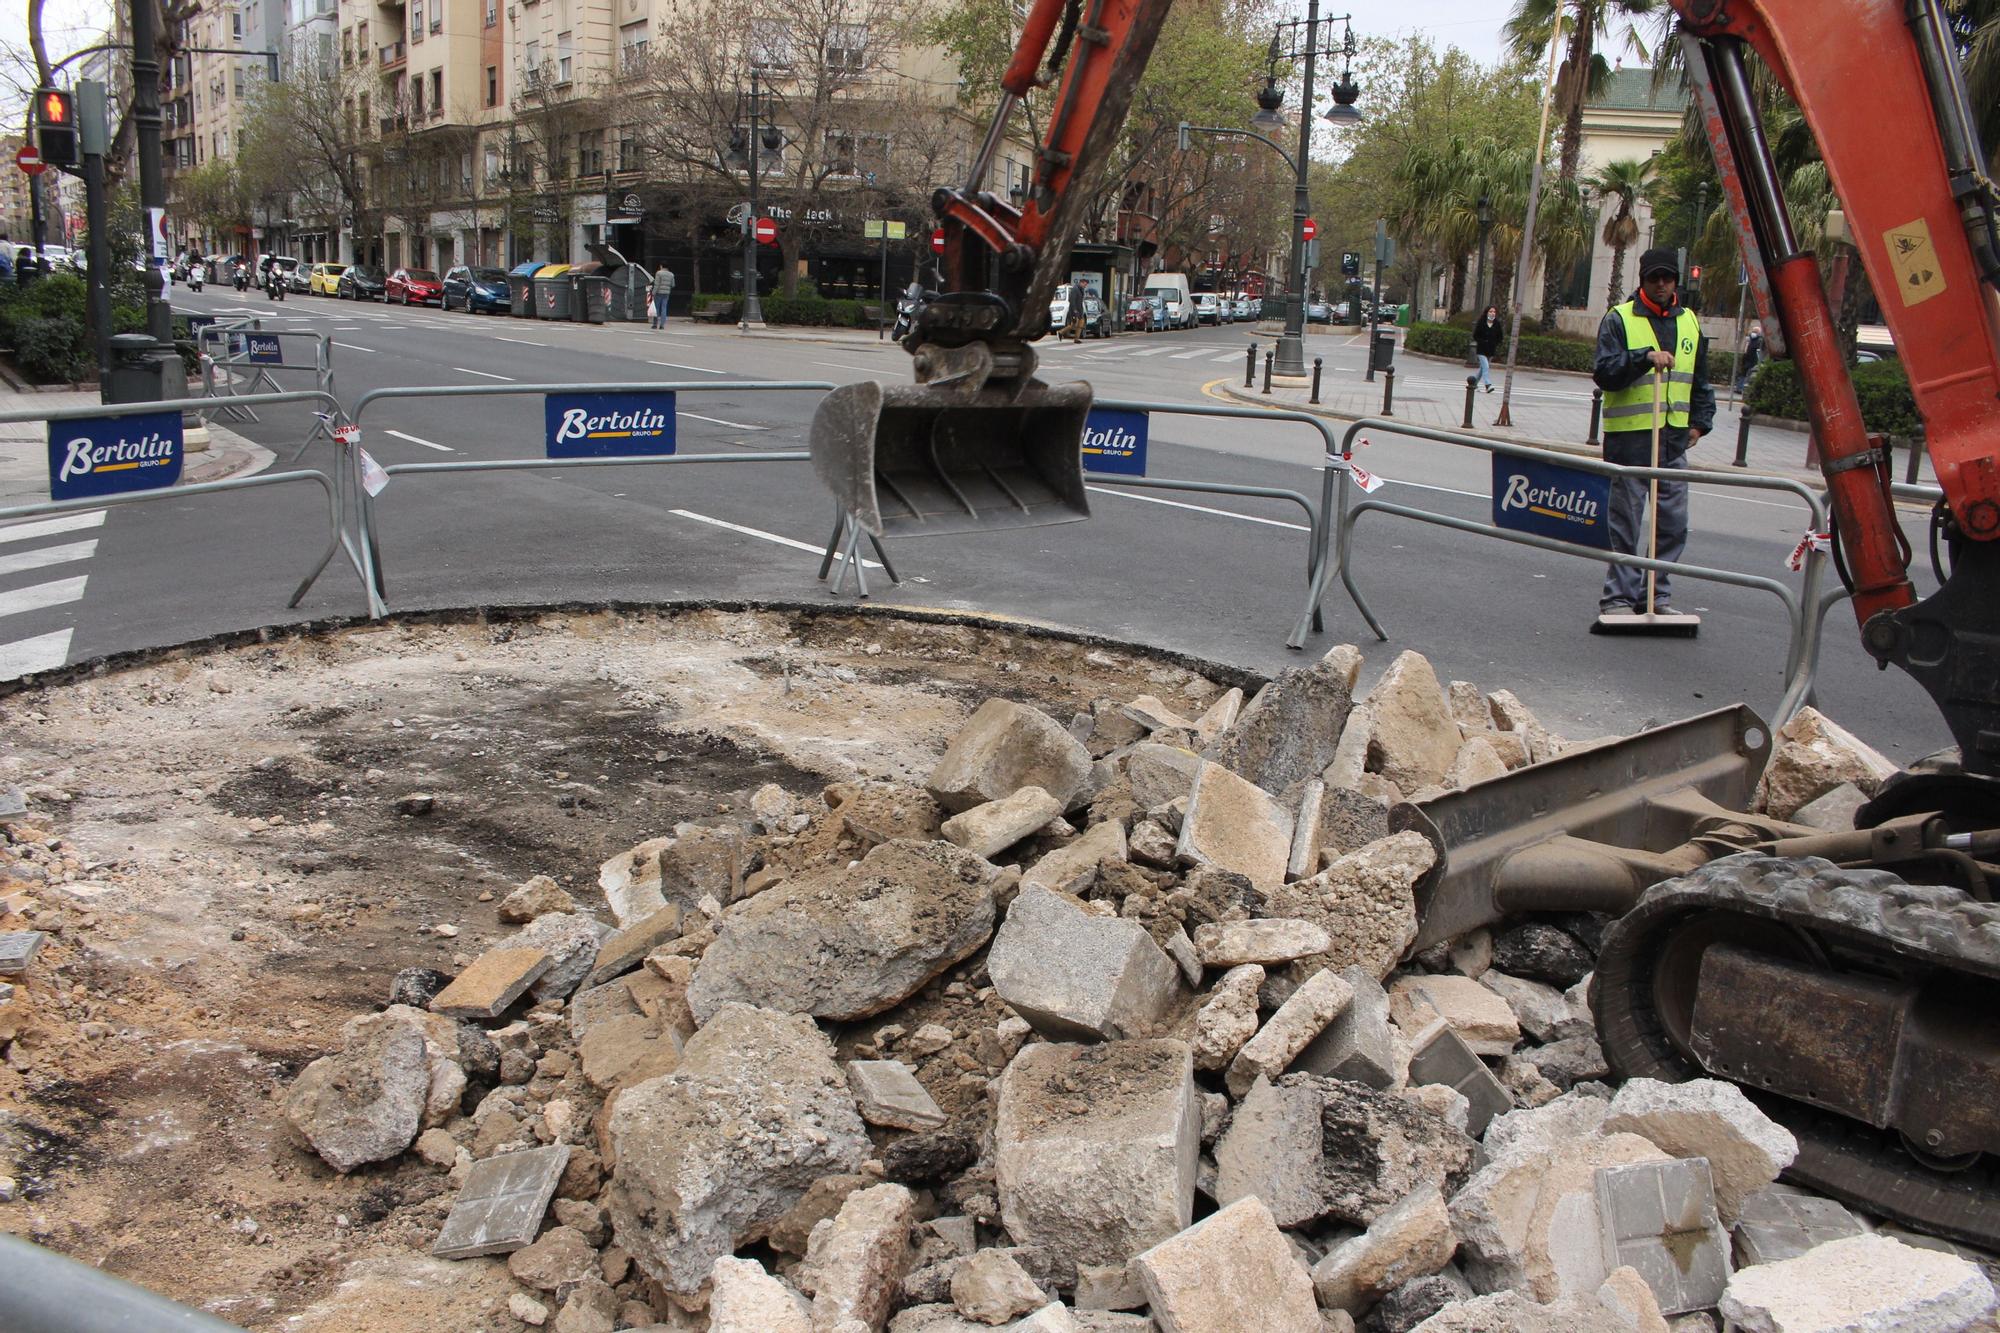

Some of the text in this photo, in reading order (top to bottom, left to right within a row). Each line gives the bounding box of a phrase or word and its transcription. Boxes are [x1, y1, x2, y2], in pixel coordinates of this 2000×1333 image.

[767, 205, 792, 219] The
[1343, 253, 1352, 264] P
[556, 408, 665, 444] Bertolín
[1082, 427, 1136, 449] tolín
[60, 433, 174, 482] Bertolín
[139, 459, 160, 468] GRUPO
[1501, 474, 1598, 517] Bertolín
[1567, 514, 1585, 524] GRUPO
